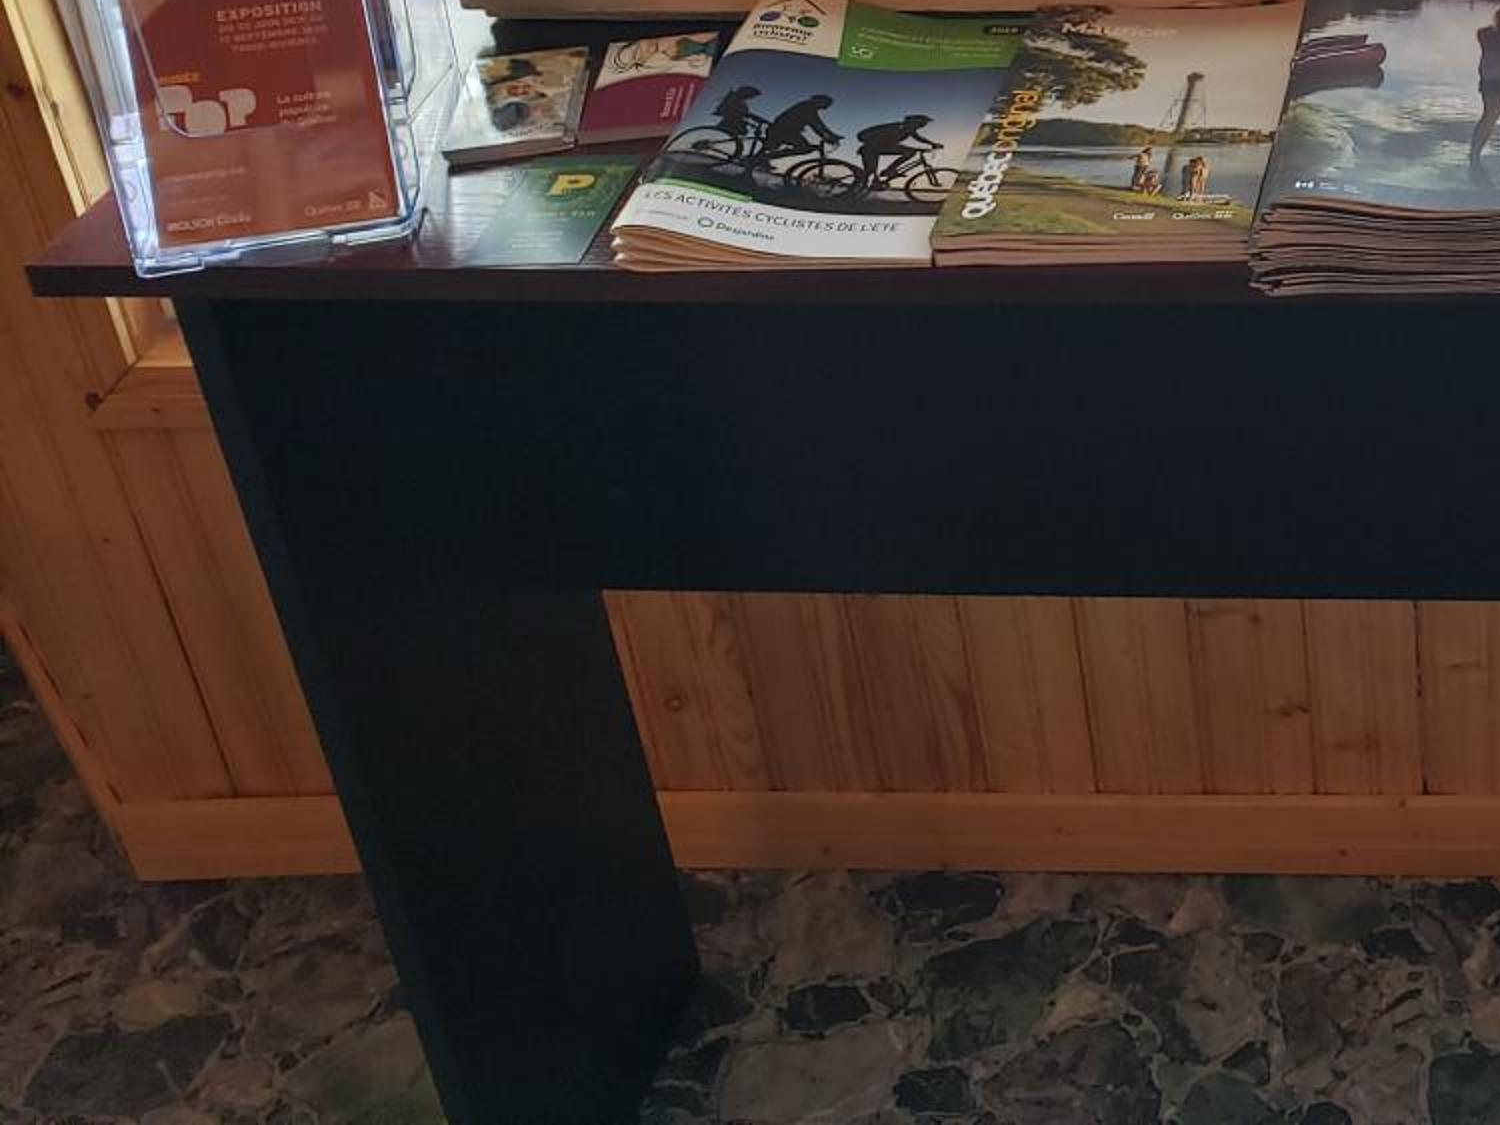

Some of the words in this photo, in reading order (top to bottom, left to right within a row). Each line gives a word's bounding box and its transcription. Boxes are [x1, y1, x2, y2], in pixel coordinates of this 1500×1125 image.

[216, 0, 322, 23] EXPOSITION
[644, 189, 674, 202] LES
[674, 192, 753, 219] ACTIVITÉS
[754, 211, 834, 232] CYCLISTES
